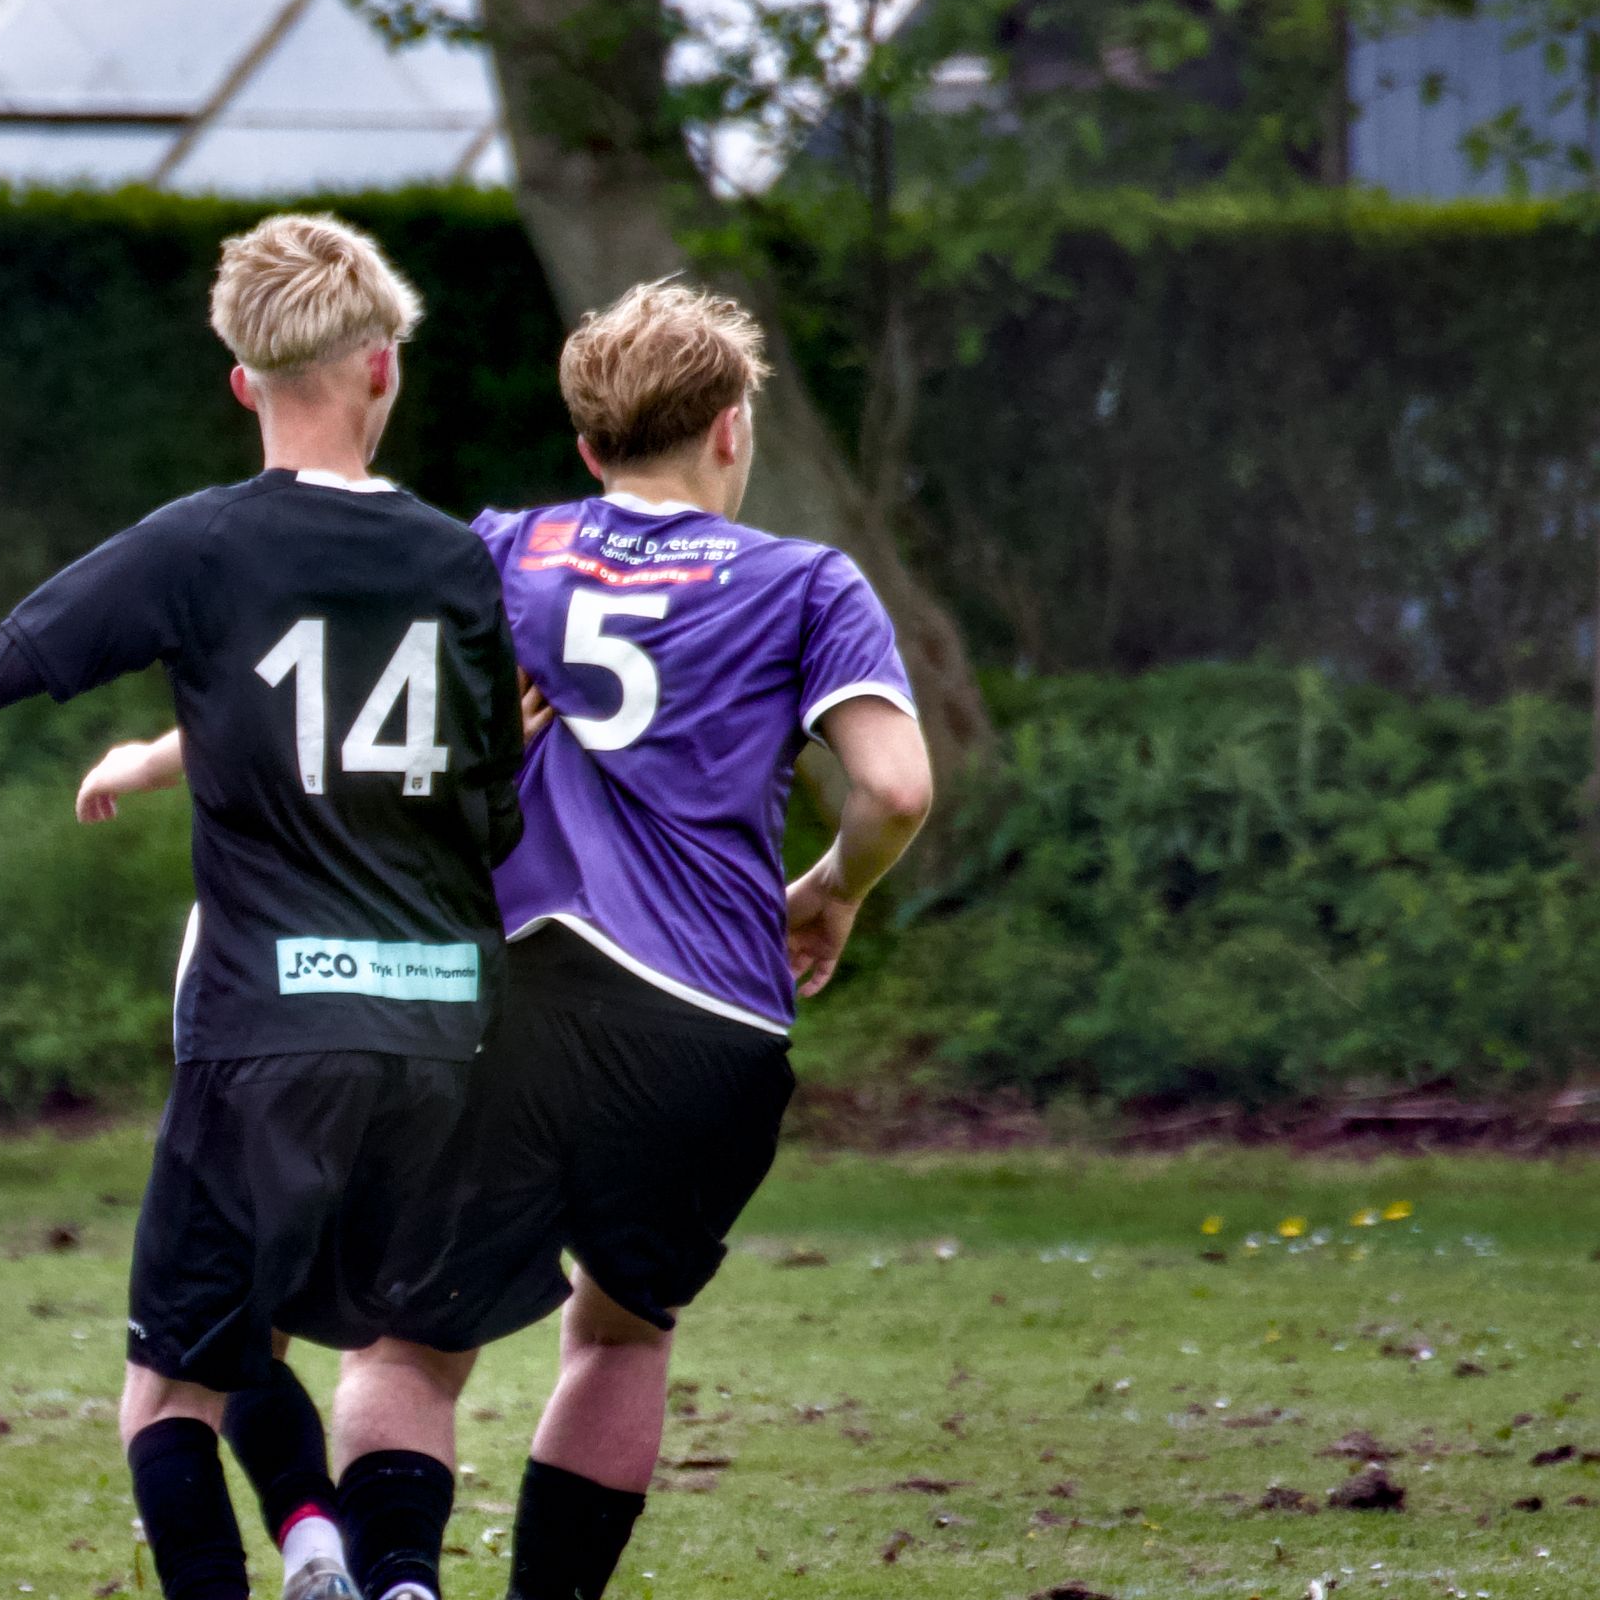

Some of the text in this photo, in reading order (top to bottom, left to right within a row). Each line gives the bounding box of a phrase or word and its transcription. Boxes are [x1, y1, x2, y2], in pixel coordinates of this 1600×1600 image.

[579, 526, 604, 539] Fa.
[607, 532, 642, 552] Karl
[644, 540, 658, 555] D
[253, 617, 450, 797] 14
[561, 589, 668, 751] 5
[369, 962, 392, 977] Tryk
